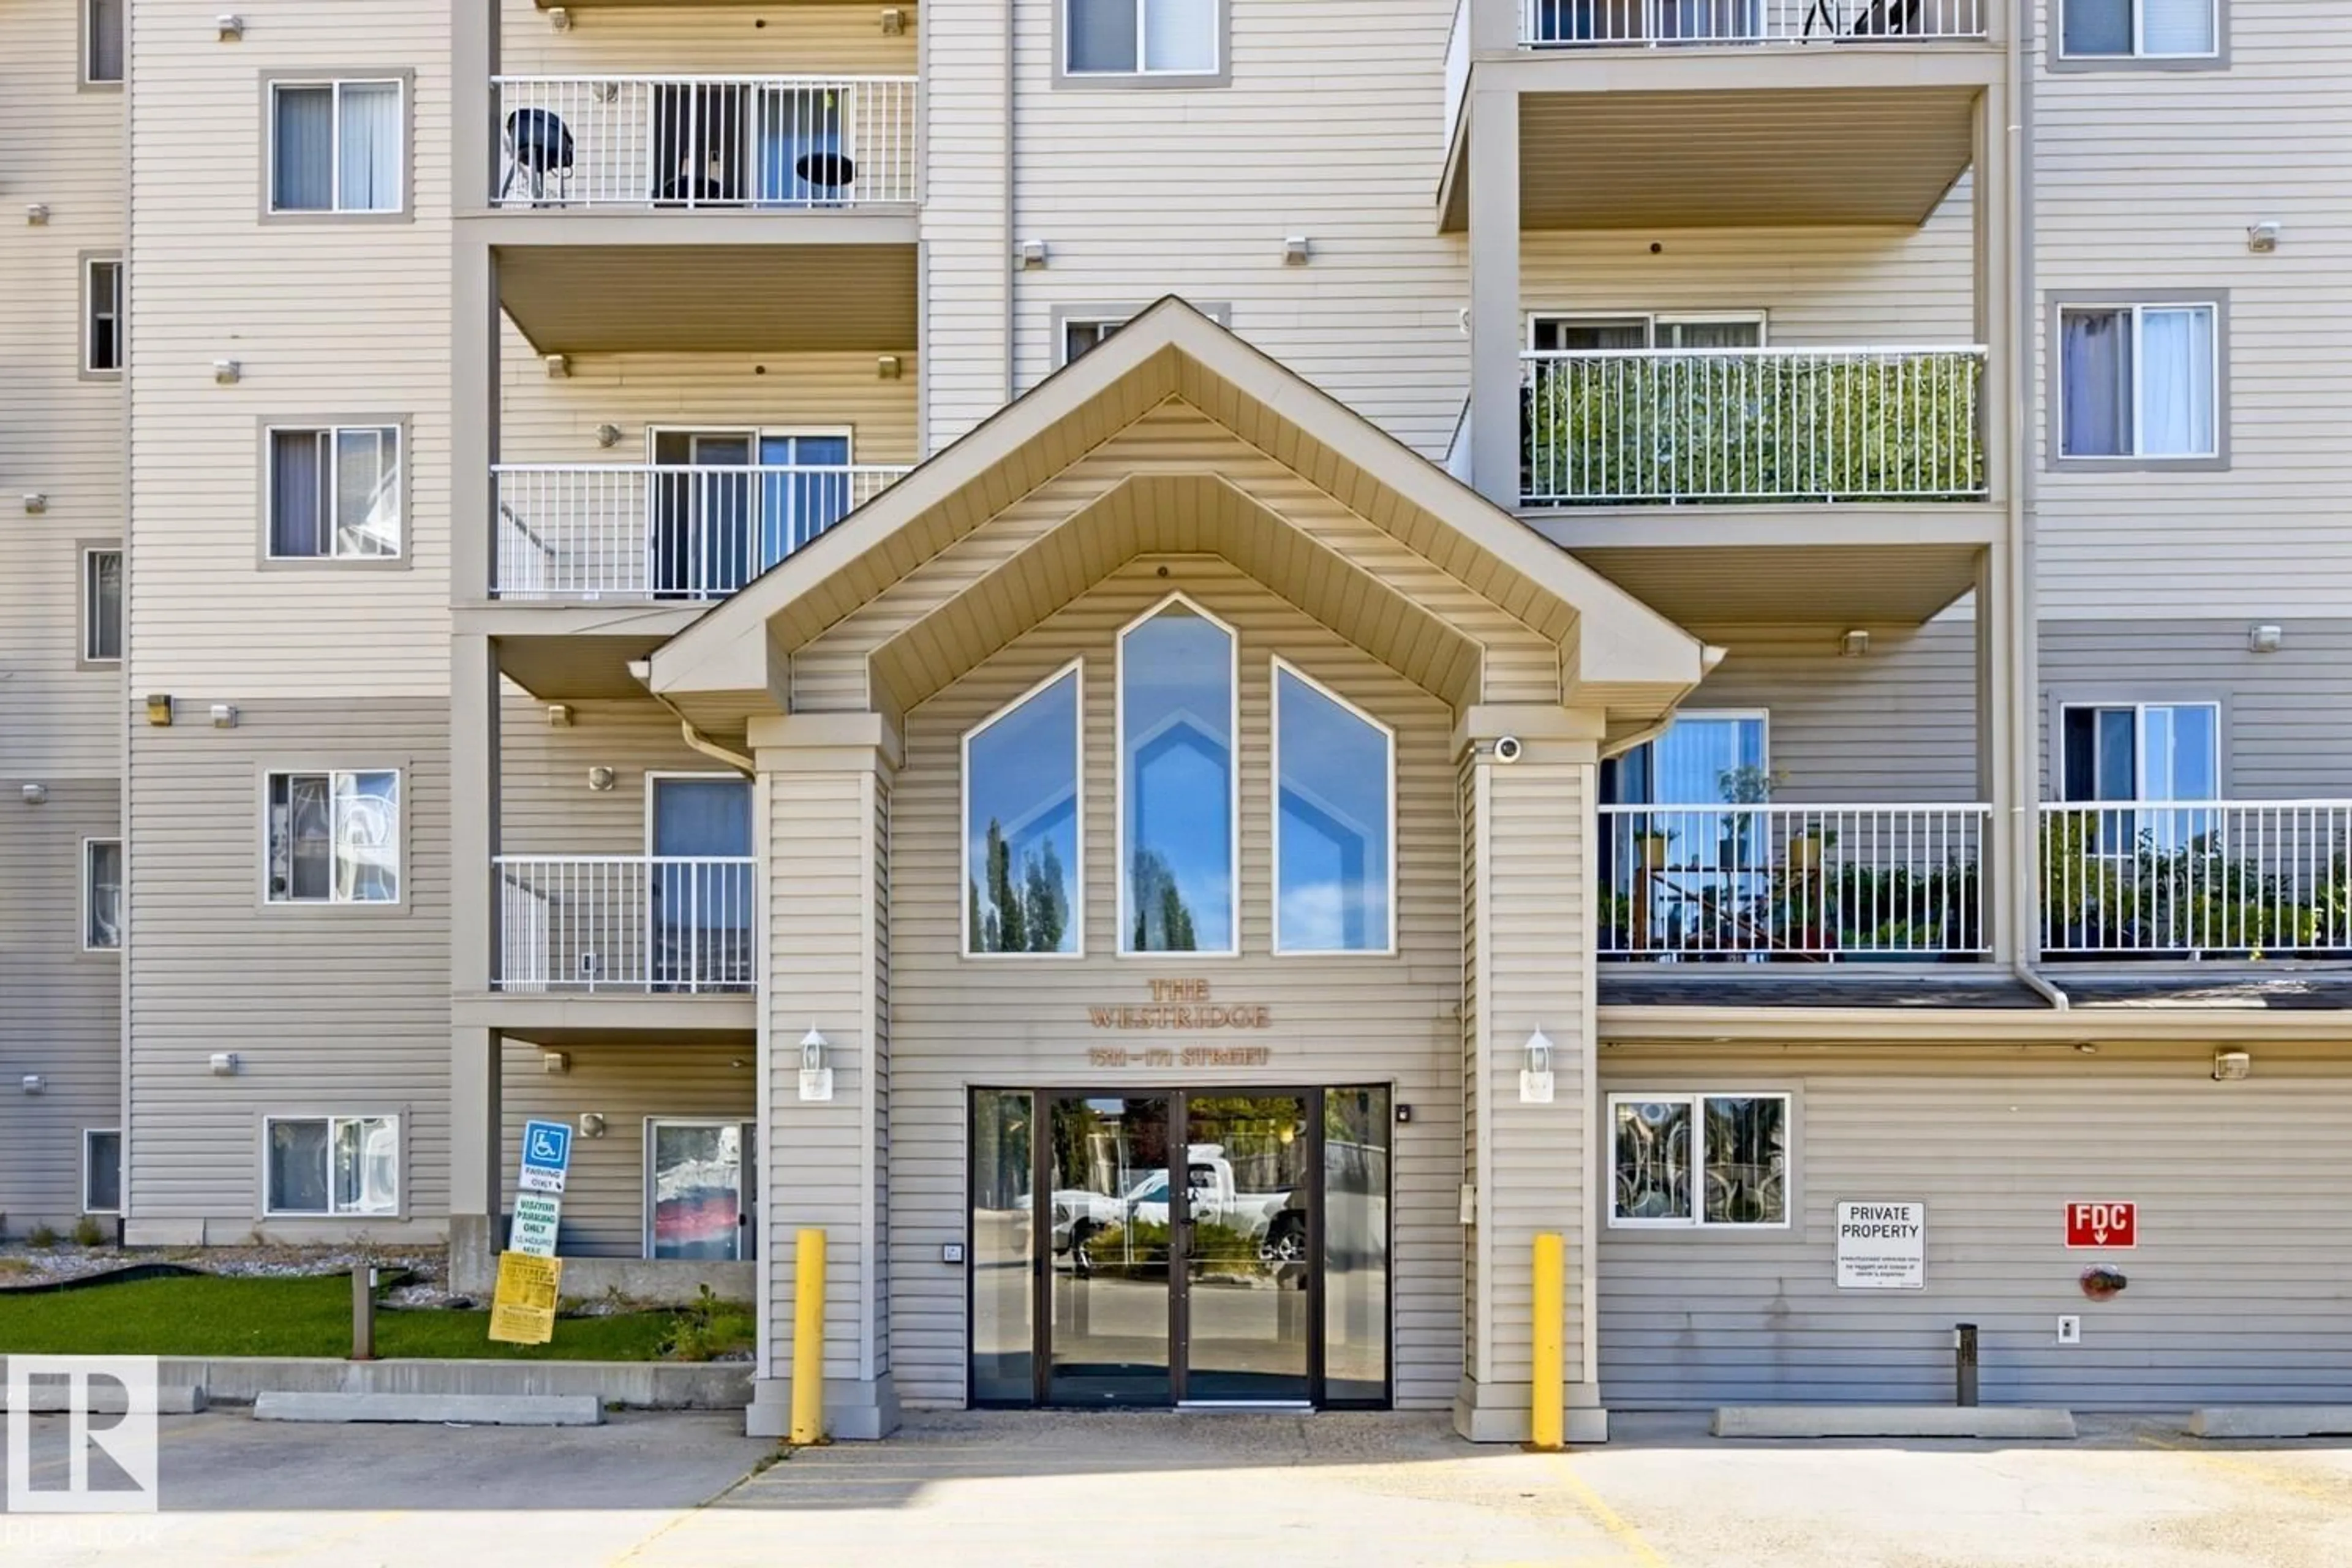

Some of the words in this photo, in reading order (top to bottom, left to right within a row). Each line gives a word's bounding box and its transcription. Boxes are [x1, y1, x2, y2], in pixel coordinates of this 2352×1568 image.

[1147, 978, 1210, 1001] THE
[1088, 1006, 1271, 1029] WESTRIDGE
[1180, 1047, 1272, 1066] STREET
[1850, 1207, 1910, 1220] PRIVATE
[2076, 1205, 2127, 1230] FDC
[524, 1223, 546, 1234] ONLY
[1842, 1224, 1918, 1238] PROPERTY
